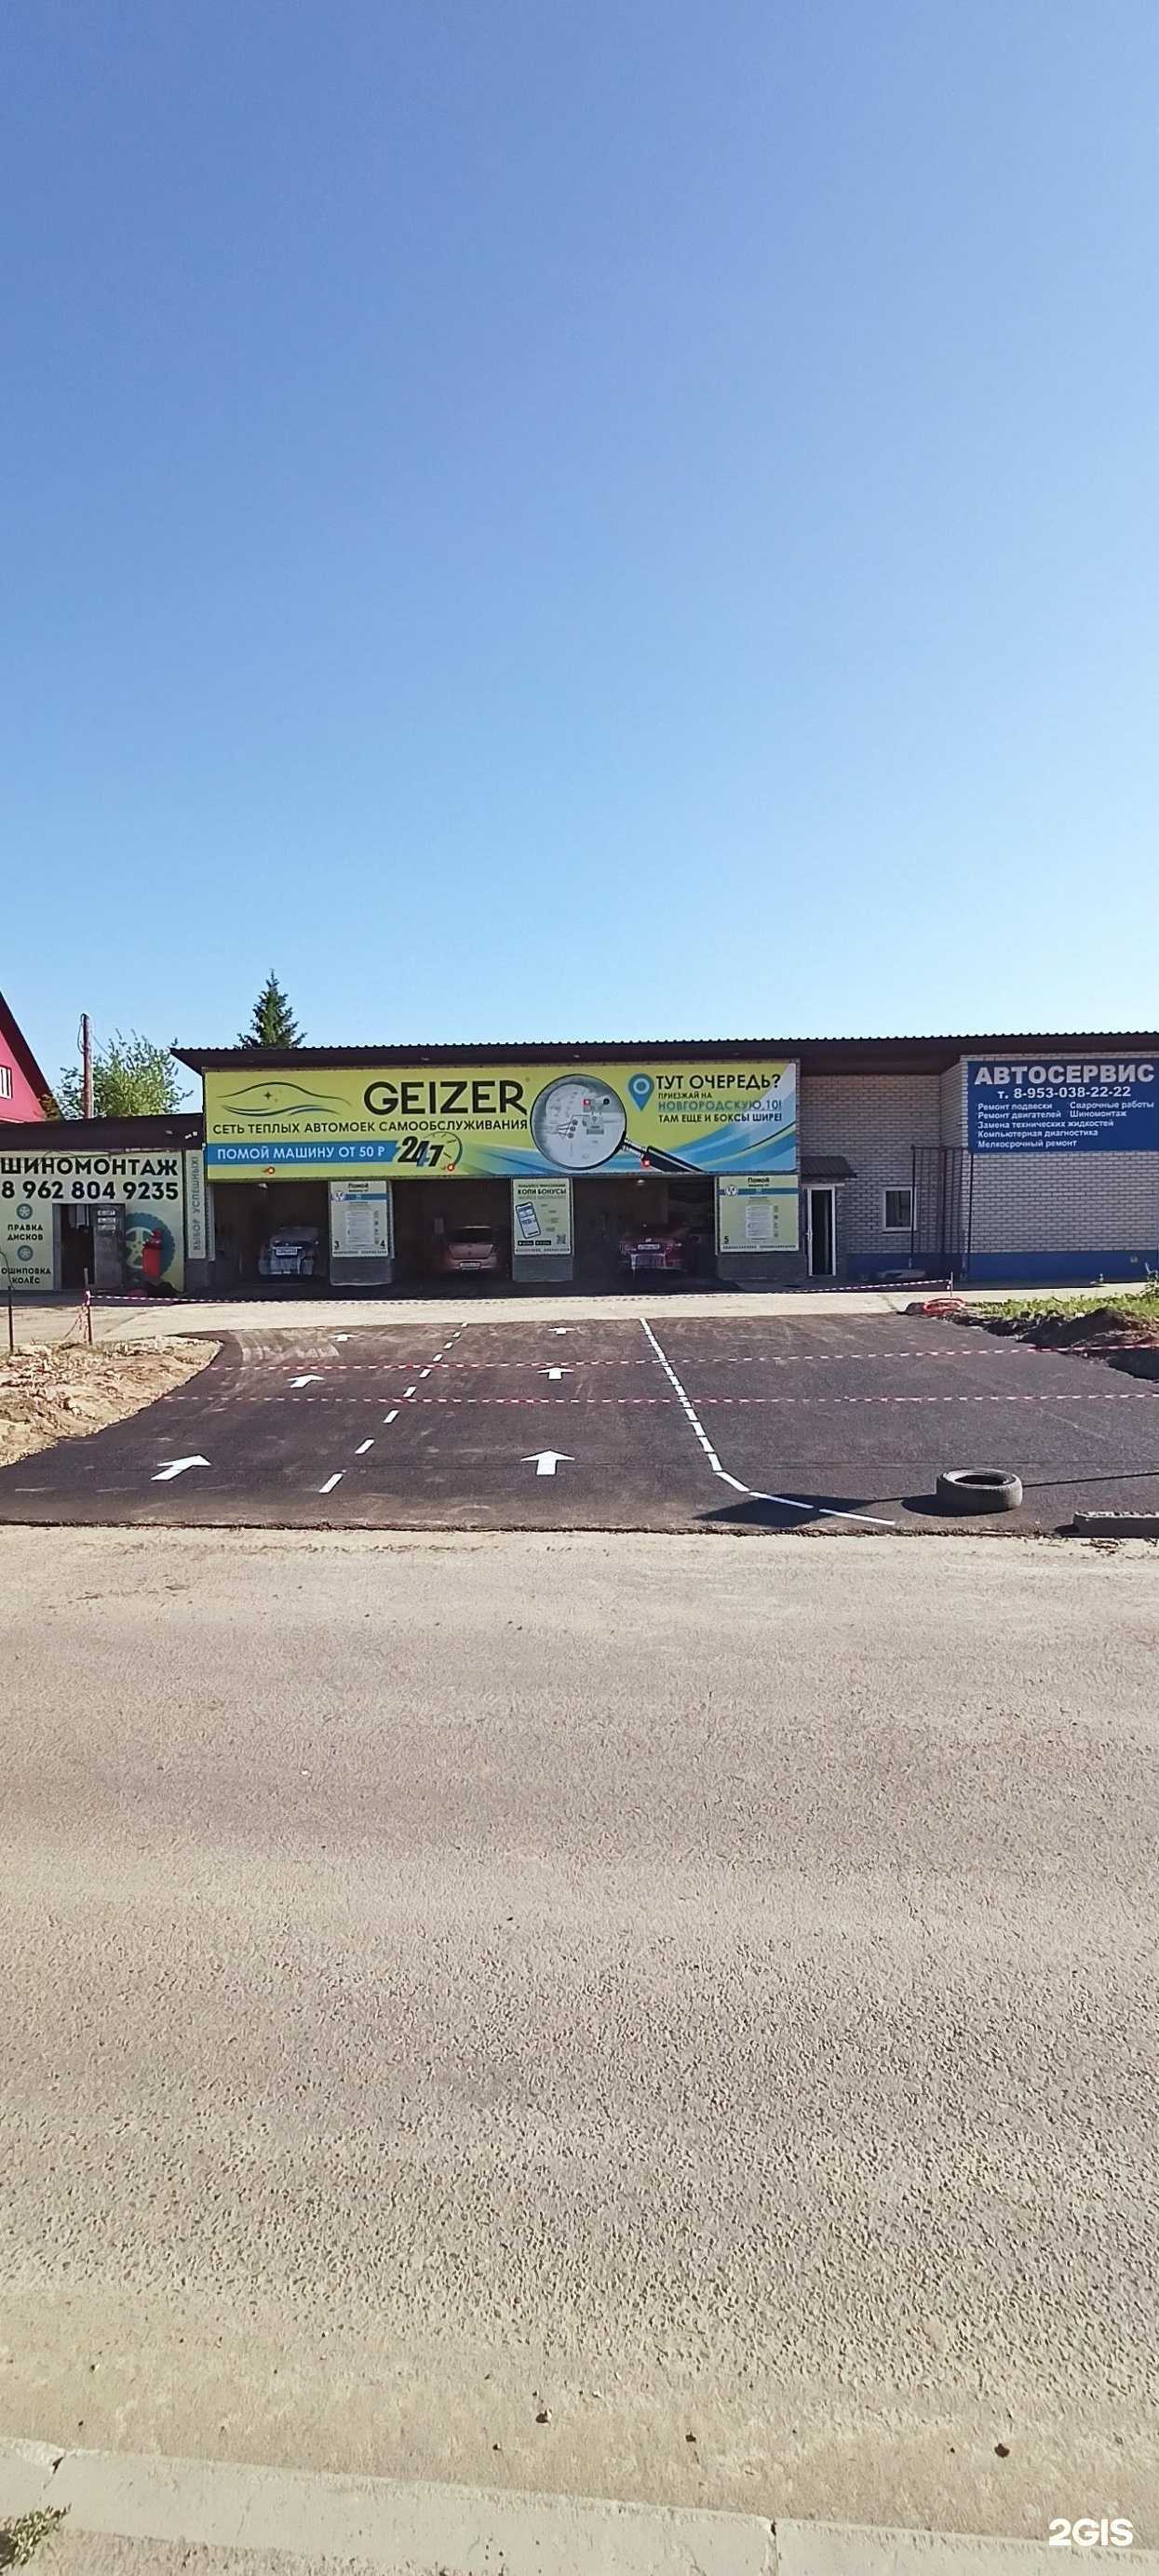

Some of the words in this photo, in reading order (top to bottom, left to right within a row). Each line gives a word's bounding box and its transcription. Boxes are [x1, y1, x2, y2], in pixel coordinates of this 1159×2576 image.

[975, 1064, 1154, 1085] АВТОСЕРВИС
[656, 1075, 683, 1090] ТУТ
[689, 1074, 781, 1091] ОЧЕРЕДЬ?
[363, 1080, 528, 1116] GEIZER
[658, 1091, 699, 1099] ПРИЕЗЖАЙ
[998, 1091, 1008, 1099] т.
[1014, 1087, 1131, 1099] 8-953-038-22-22
[1011, 1103, 1052, 1111] подвески
[1070, 1102, 1119, 1110] Сварочные
[1121, 1100, 1154, 1109] работы
[658, 1114, 679, 1122] ТАМ
[681, 1114, 703, 1123] ЕЩЕ
[705, 1114, 711, 1122] И
[714, 1113, 749, 1122] БОКСЫ
[752, 1113, 782, 1122] ШИРЕ!
[1011, 1110, 1061, 1119] двигателей
[213, 1124, 245, 1134] СЕТЬ
[248, 1123, 301, 1134] ТЕПЛЫХ
[304, 1121, 375, 1134] АВТОМОЕК
[379, 1120, 528, 1132] САМООБСЛУЖИВАНИЯ
[1068, 1119, 1114, 1128] жидкостей
[977, 1130, 1042, 1138] Компьютерная
[1044, 1129, 1098, 1138] диагностика
[977, 1140, 1044, 1148] Мелкосрочный
[1045, 1140, 1077, 1148] ремонт
[217, 1146, 269, 1160] ПОМОЙ
[274, 1146, 334, 1160] МАШИНУ
[338, 1146, 356, 1158] ОТ
[358, 1146, 373, 1158] 50
[0, 1158, 179, 1176] ШИНОМОНТАЖ
[1, 1180, 15, 1199] 8
[22, 1180, 63, 1199] 962
[71, 1181, 115, 1200] 804
[122, 1181, 179, 1201] 9235
[7, 1233, 44, 1241] ДИСКОВ
[193, 1219, 201, 1251] ВЫБОР
[1, 1267, 51, 1275] ОШИПОВКА
[12, 1275, 41, 1284] КОЛЁС
